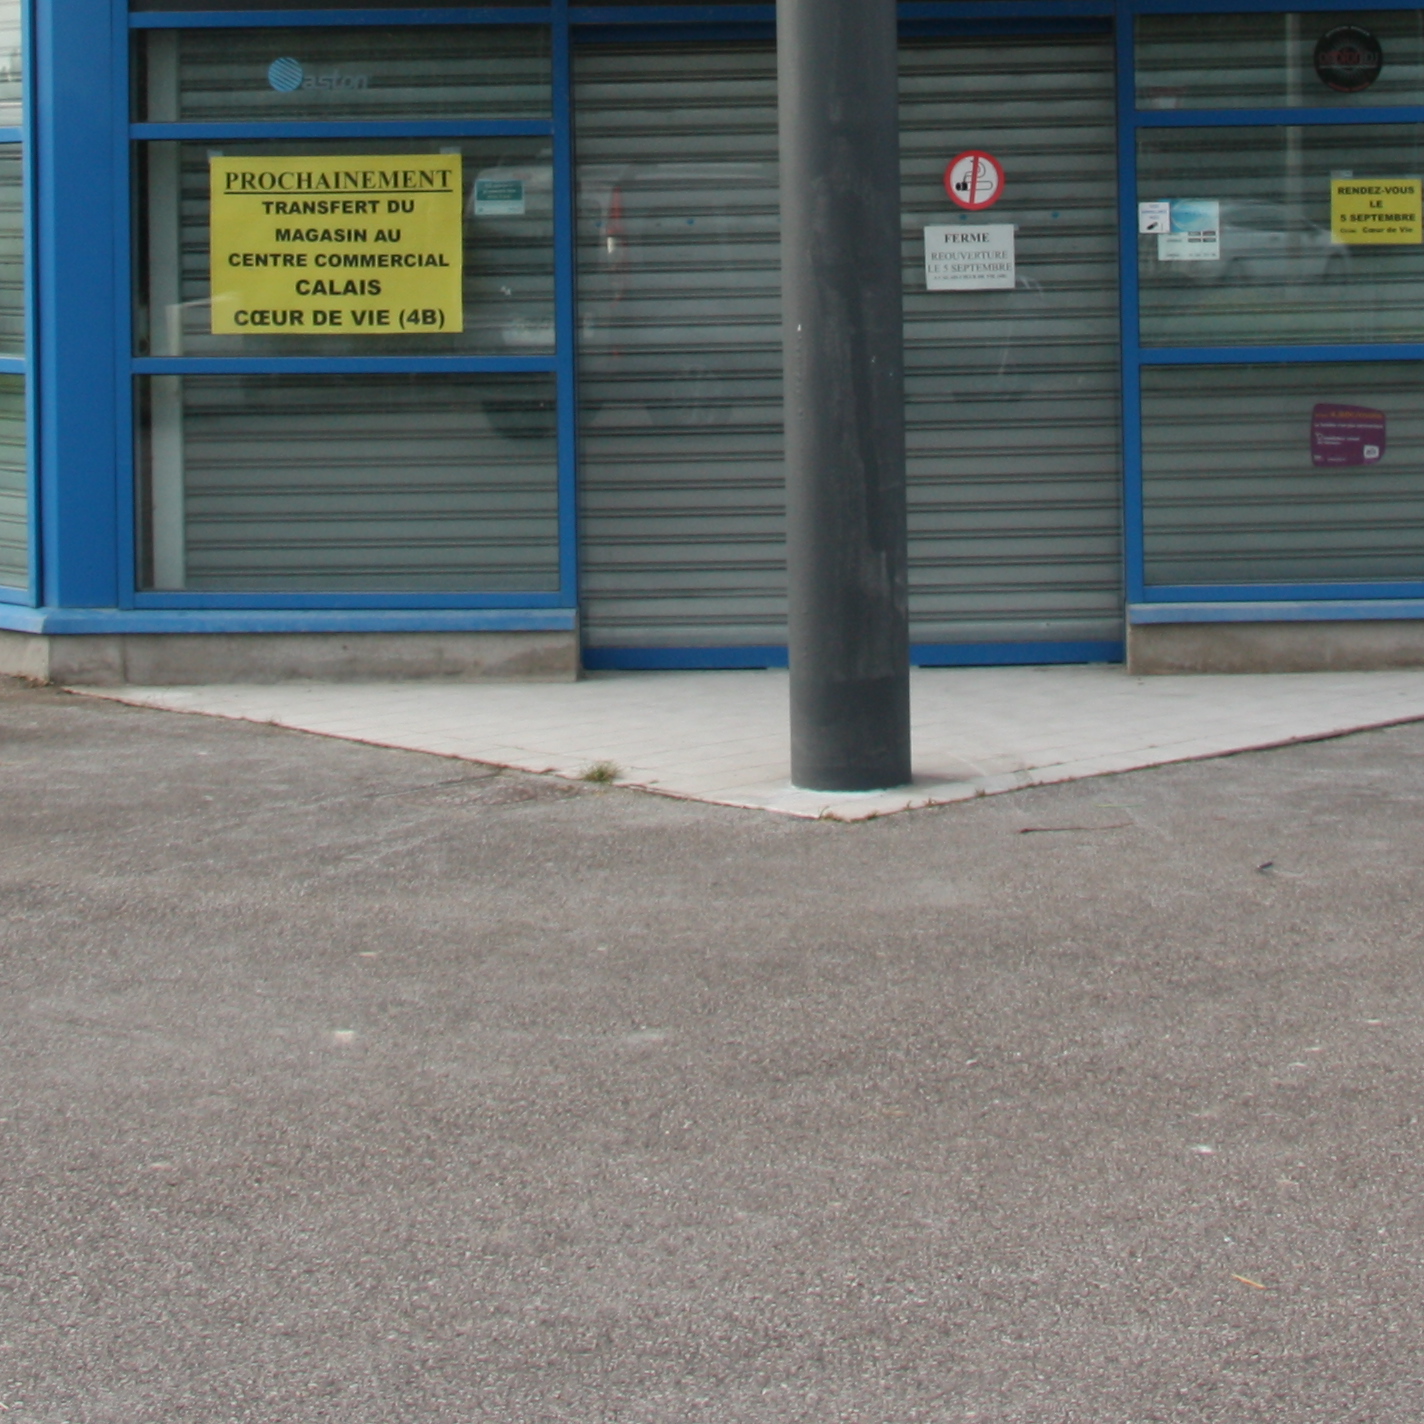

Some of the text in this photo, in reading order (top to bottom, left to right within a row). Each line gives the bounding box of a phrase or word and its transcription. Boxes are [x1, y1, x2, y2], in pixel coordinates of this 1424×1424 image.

[302, 69, 368, 90] aston
[224, 169, 452, 191] PROCHAINEMENT
[1337, 186, 1415, 195] RENDEZ-VOUS
[262, 199, 415, 215] TRANSFERT DU
[1369, 200, 1383, 208] LE
[1340, 213, 1416, 222] 5 SEPTEMBRE
[275, 228, 401, 243] MAGASIN AU
[228, 253, 450, 268] CENTRE COMMERCIAL
[927, 264, 940, 273] LE
[951, 263, 1012, 273] SEPTEMBRE
[295, 278, 382, 296] CALAIS
[233, 308, 445, 330] CŒUR DE VIE (4B)
